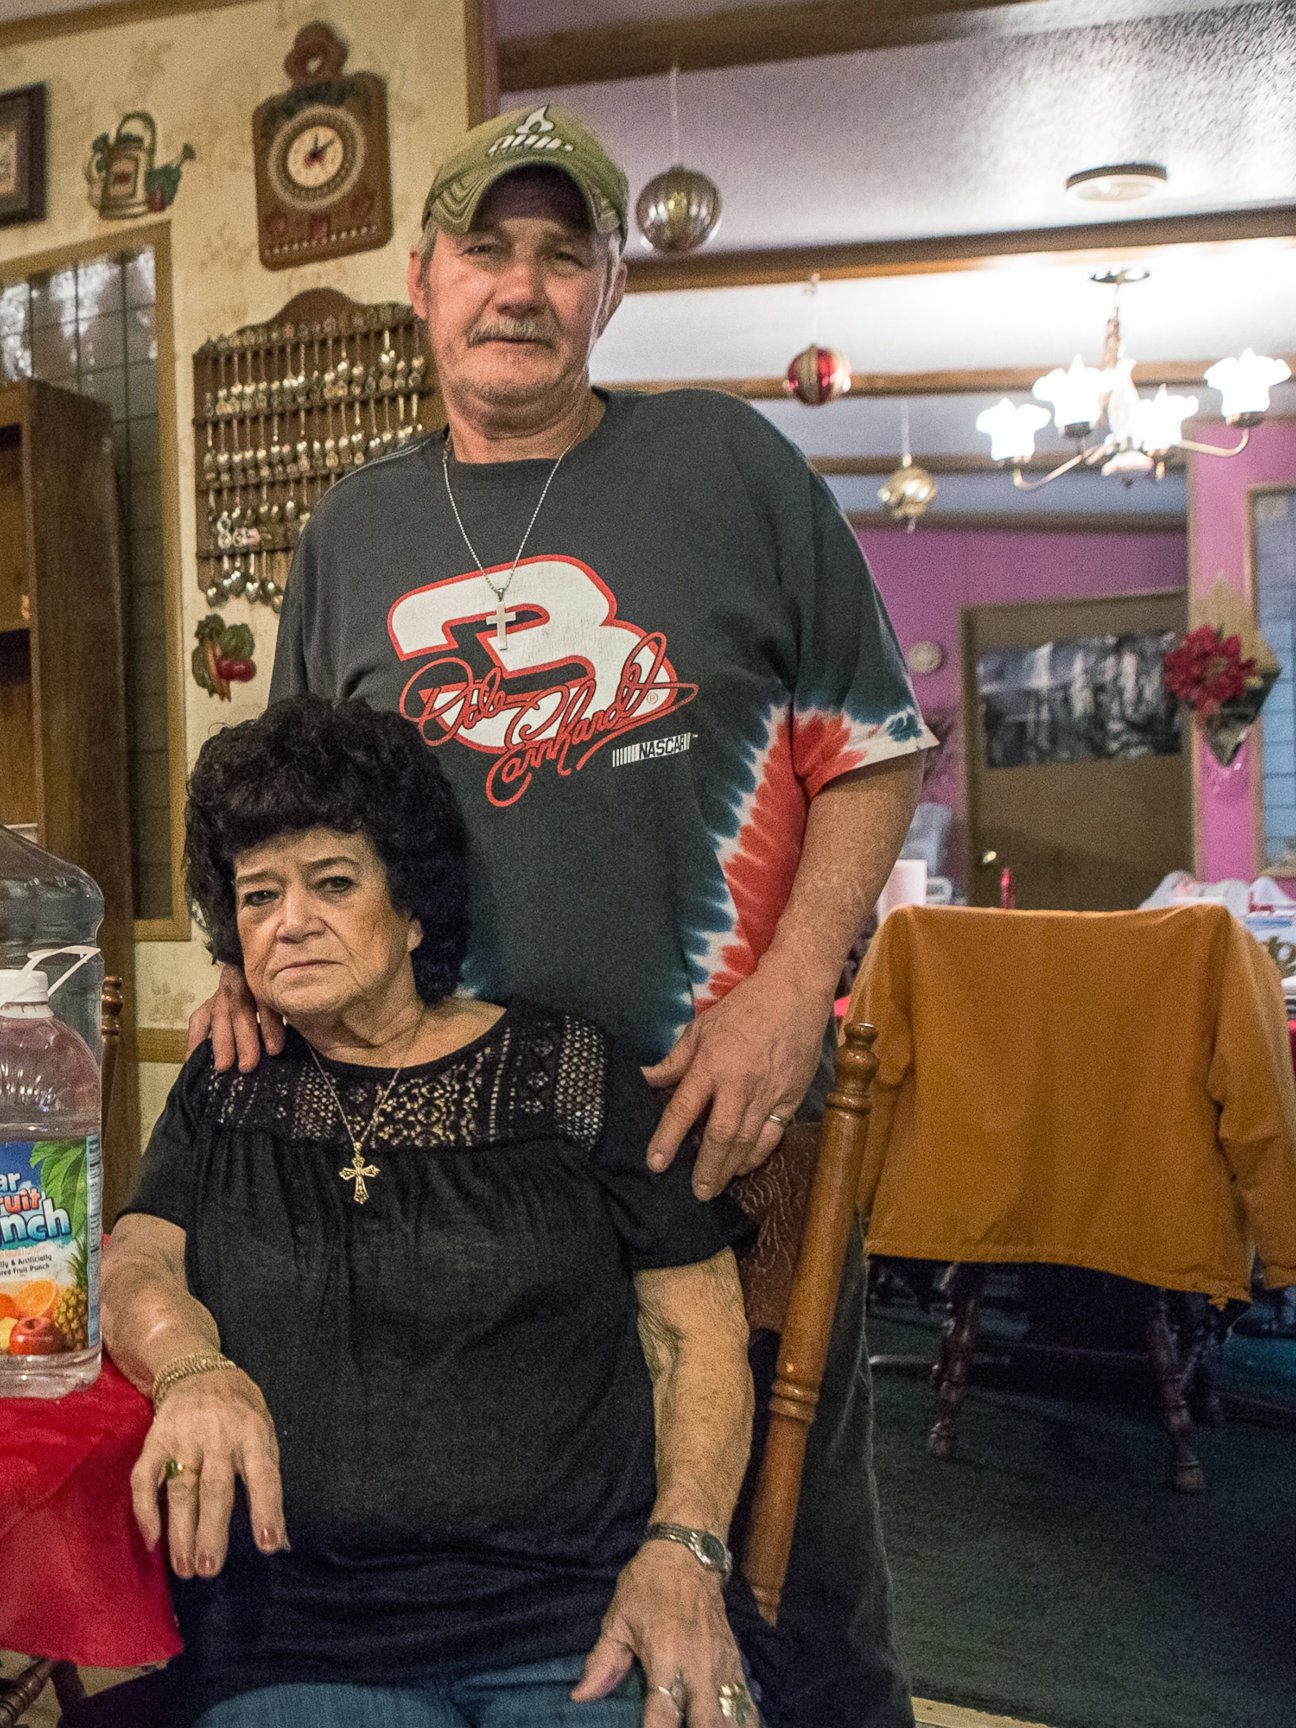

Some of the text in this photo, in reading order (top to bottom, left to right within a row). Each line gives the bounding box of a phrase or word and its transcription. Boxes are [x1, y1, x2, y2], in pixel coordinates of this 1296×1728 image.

[387, 553, 678, 754] 3
[400, 657, 509, 746] Dale
[638, 735, 687, 760] NASCAR
[13, 1266, 28, 1274] Fruit
[30, 1263, 50, 1271] Punch
[18, 1254, 52, 1264] Artificially
